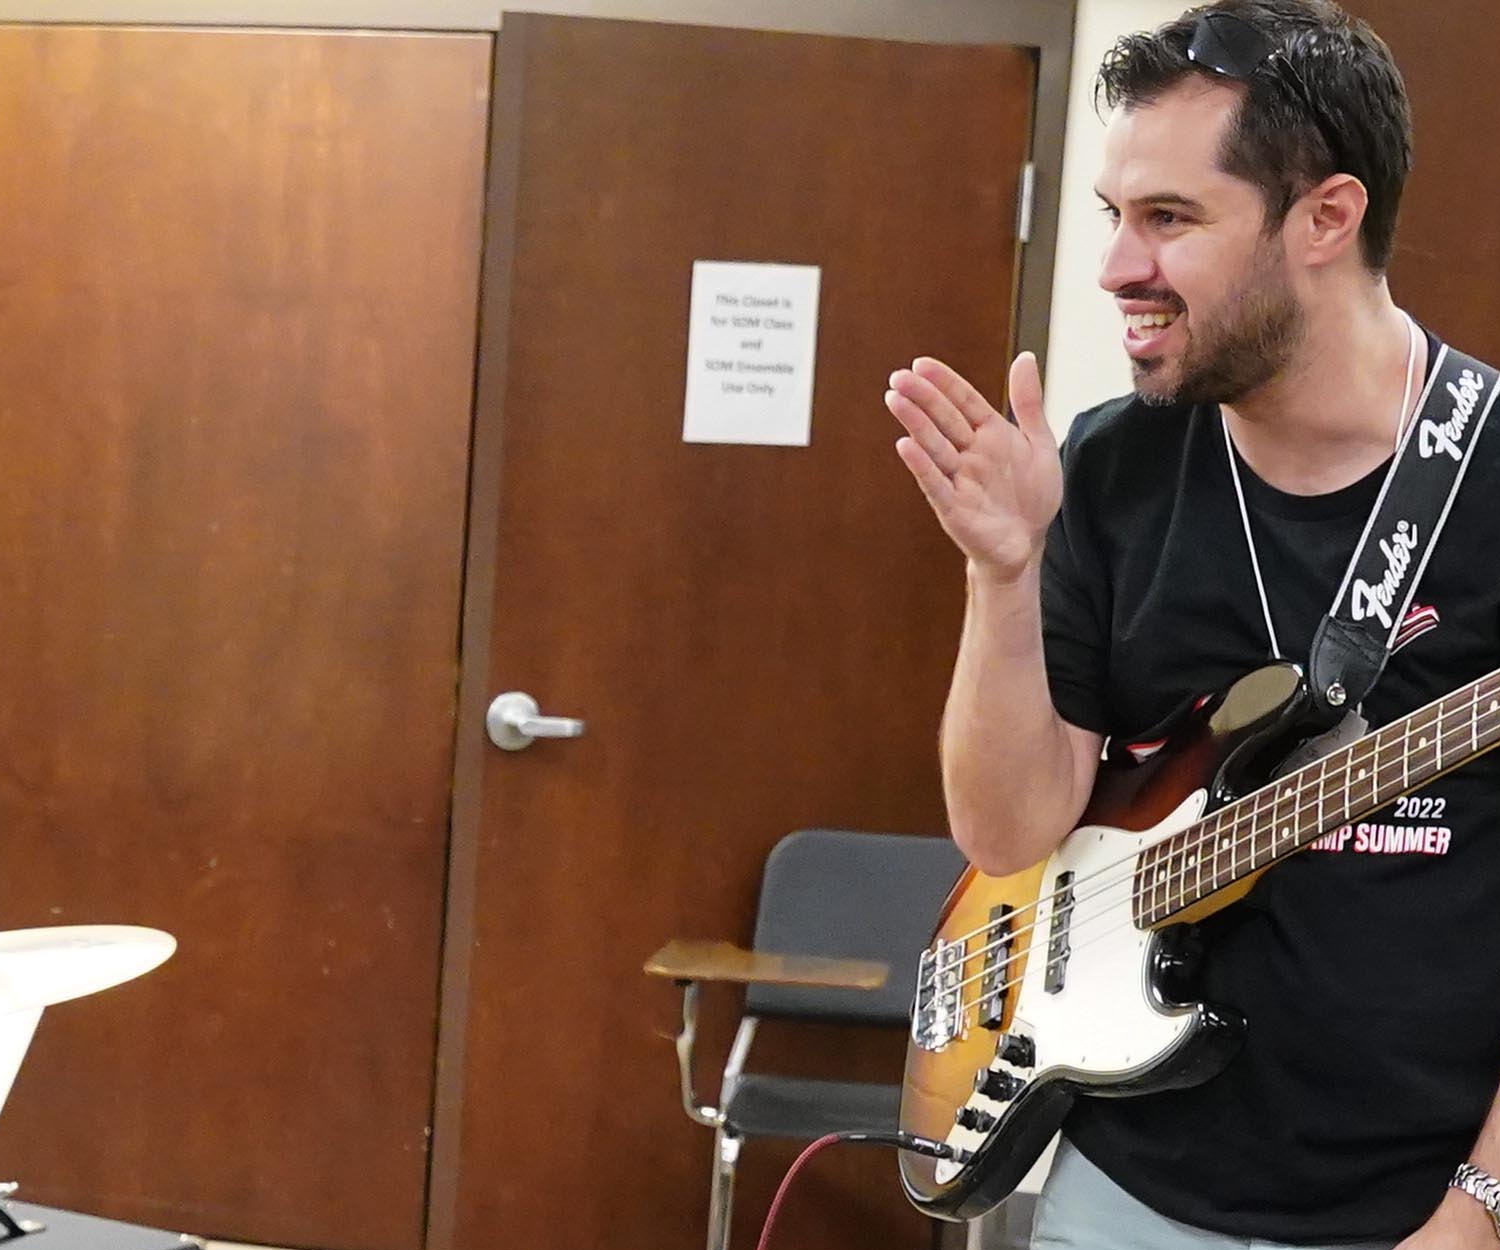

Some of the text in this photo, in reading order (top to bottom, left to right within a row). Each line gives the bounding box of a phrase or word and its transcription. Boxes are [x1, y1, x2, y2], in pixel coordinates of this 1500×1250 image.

[740, 340, 763, 351] and
[1418, 368, 1485, 461] Fender
[1350, 519, 1418, 629] Fender
[1394, 796, 1447, 820] 2022
[1353, 822, 1452, 856] SUMMER
